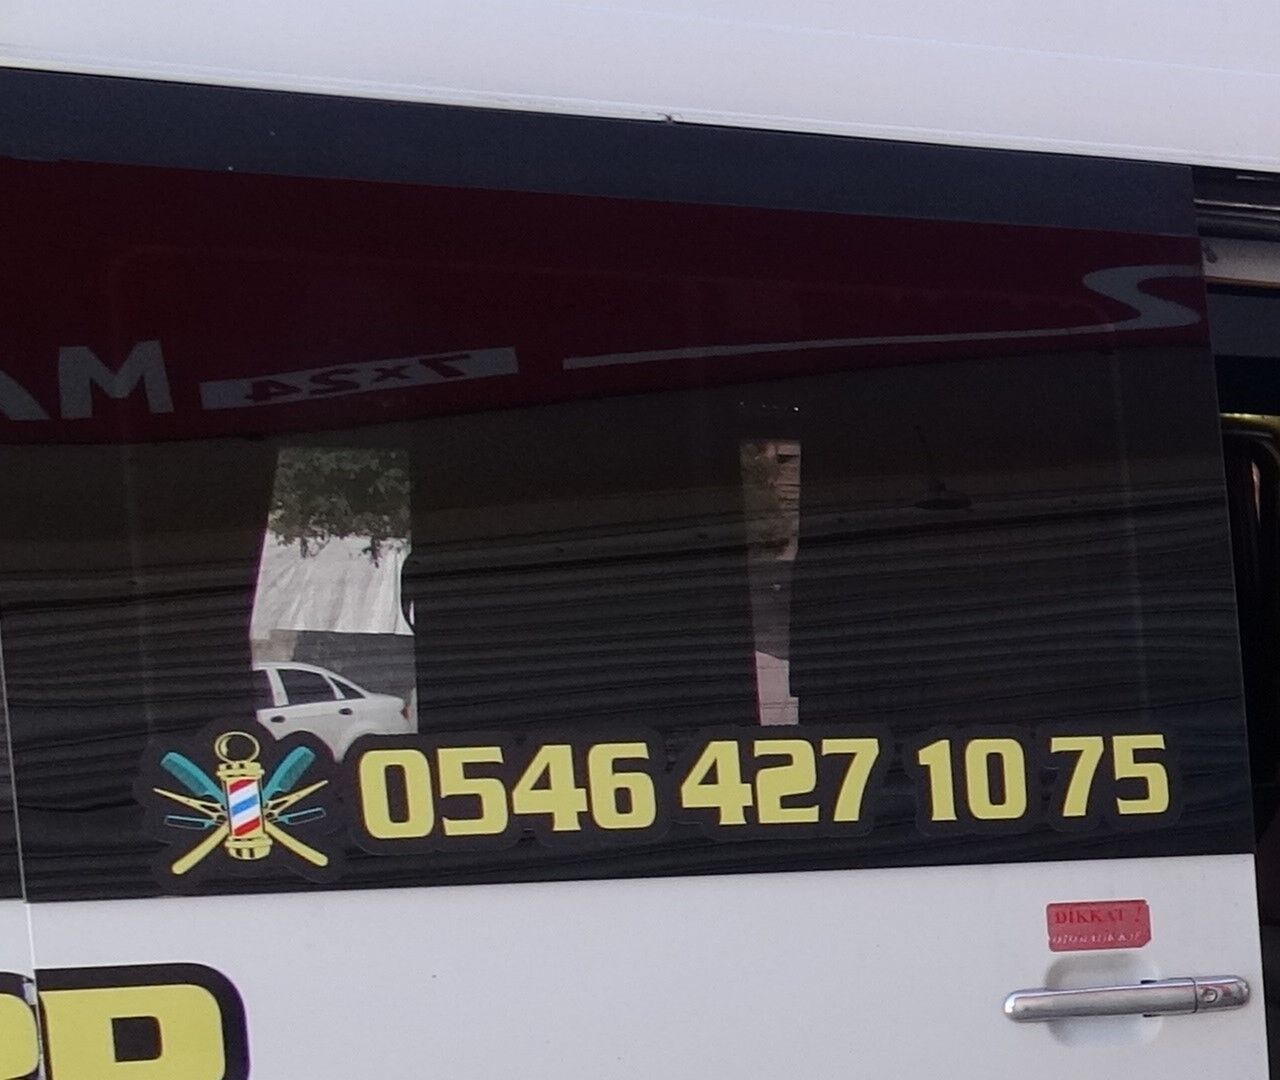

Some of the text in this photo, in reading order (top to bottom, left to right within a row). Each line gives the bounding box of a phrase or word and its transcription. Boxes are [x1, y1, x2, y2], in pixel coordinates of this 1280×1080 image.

[360, 735, 1168, 838] 0546 427 10 75
